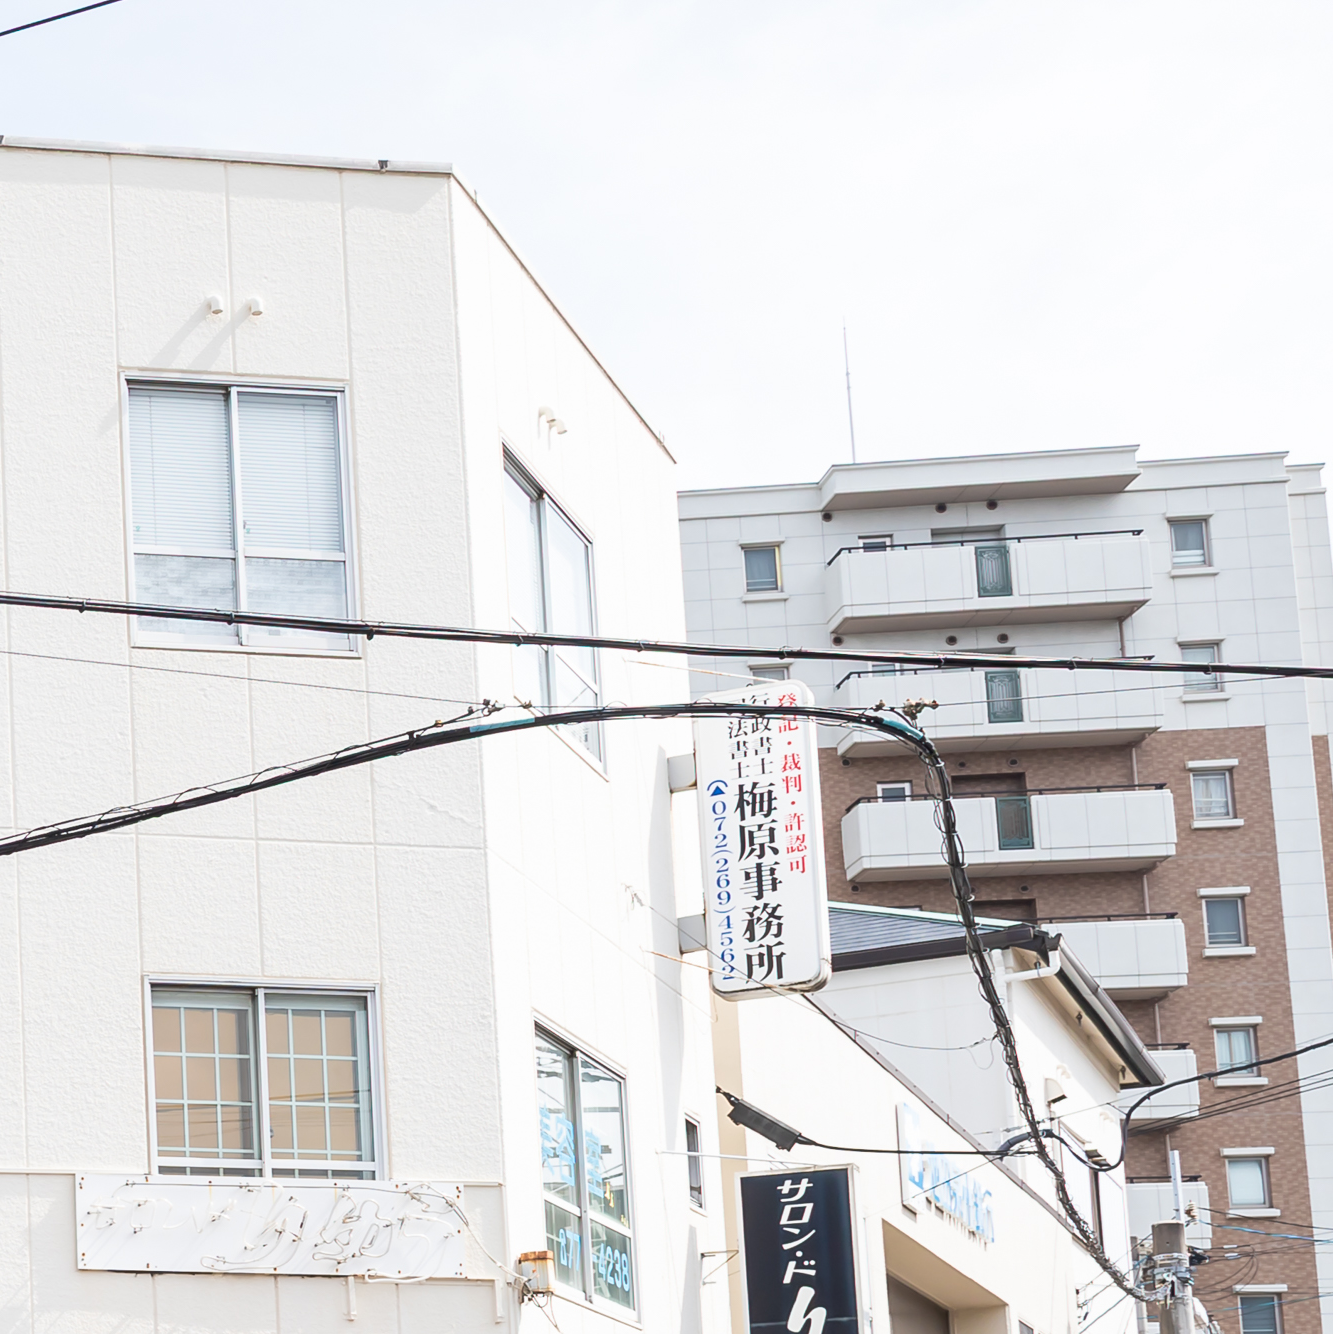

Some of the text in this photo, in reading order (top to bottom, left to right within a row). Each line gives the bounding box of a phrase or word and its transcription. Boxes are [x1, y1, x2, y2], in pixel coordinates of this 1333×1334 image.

[733, 780, 787, 984] 梅原事務所
